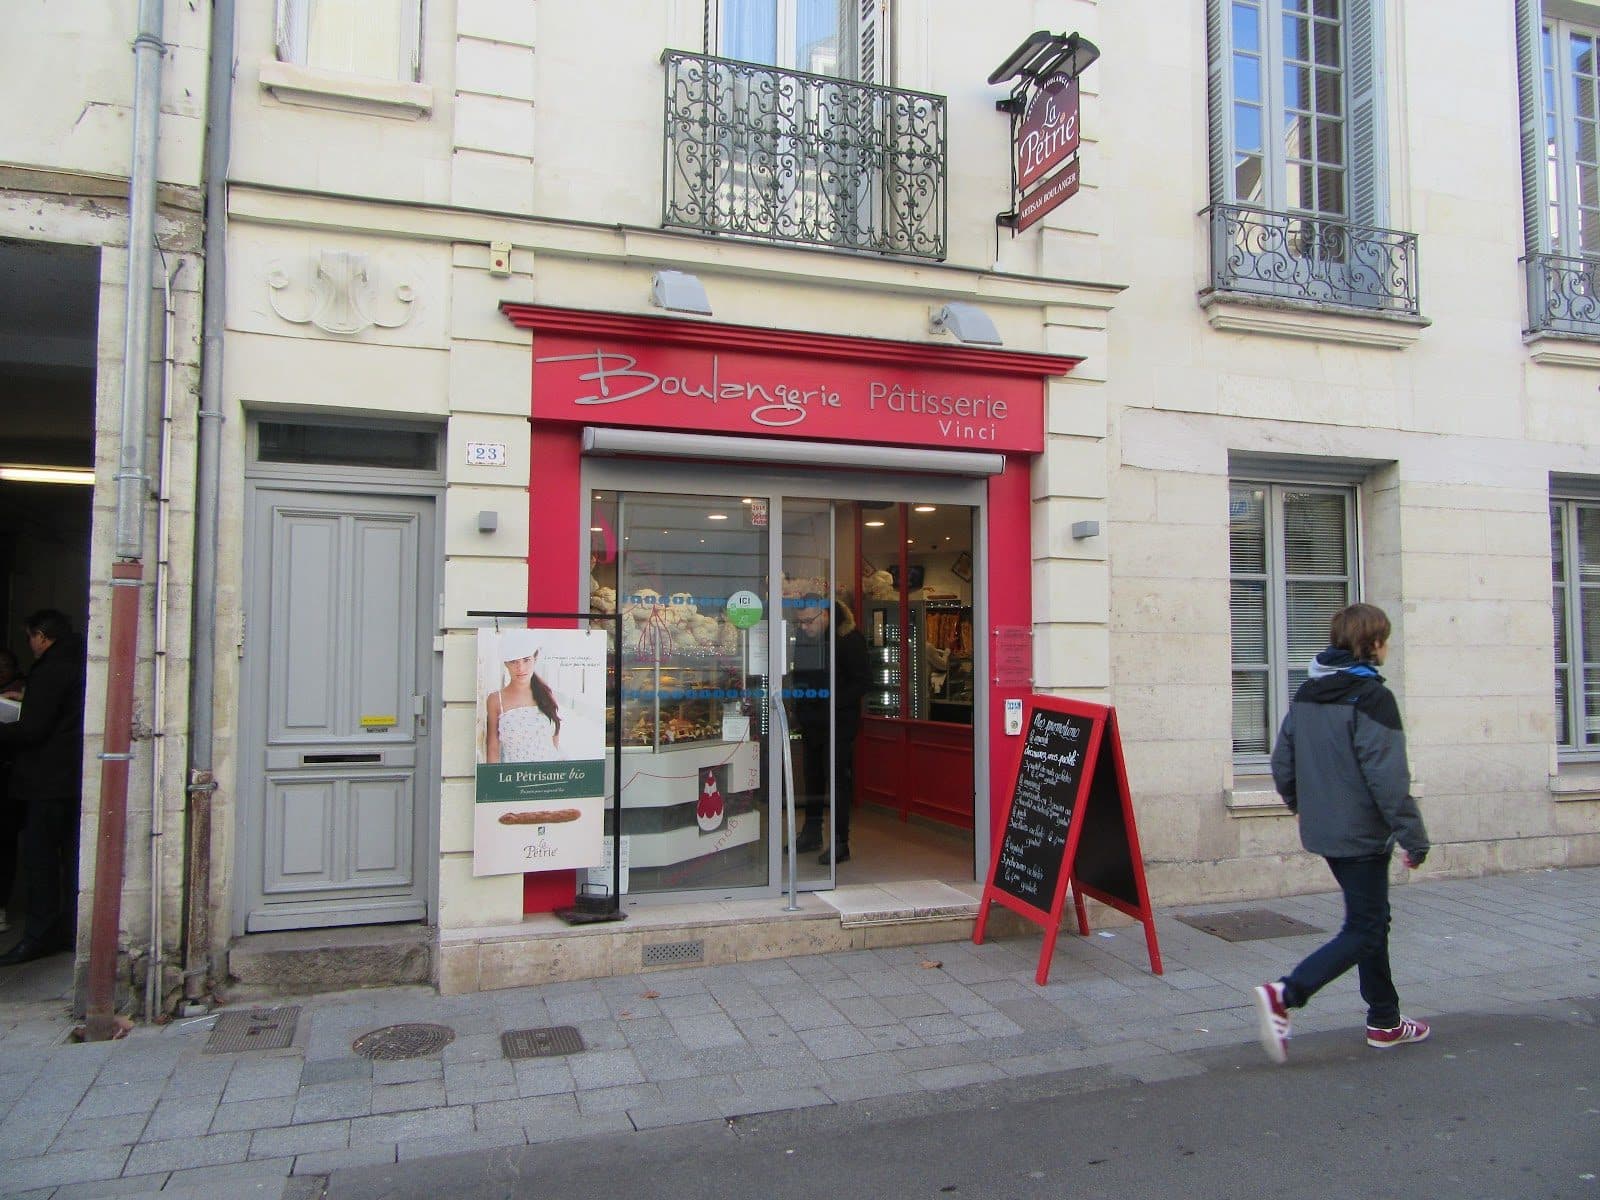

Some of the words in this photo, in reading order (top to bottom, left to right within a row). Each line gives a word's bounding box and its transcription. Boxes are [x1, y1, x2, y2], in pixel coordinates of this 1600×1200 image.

[1041, 97, 1061, 128] La
[1020, 194, 1043, 220] ARTISAN
[1043, 172, 1077, 203] BOULANGER
[536, 348, 842, 427] Boulangerie
[869, 382, 1008, 419] Pâtisserie
[938, 420, 996, 441] Vinci
[476, 447, 497, 460] 23
[739, 597, 751, 605] ICI
[499, 772, 512, 783] La
[516, 771, 567, 782] Pétrisane
[568, 767, 586, 780] bio
